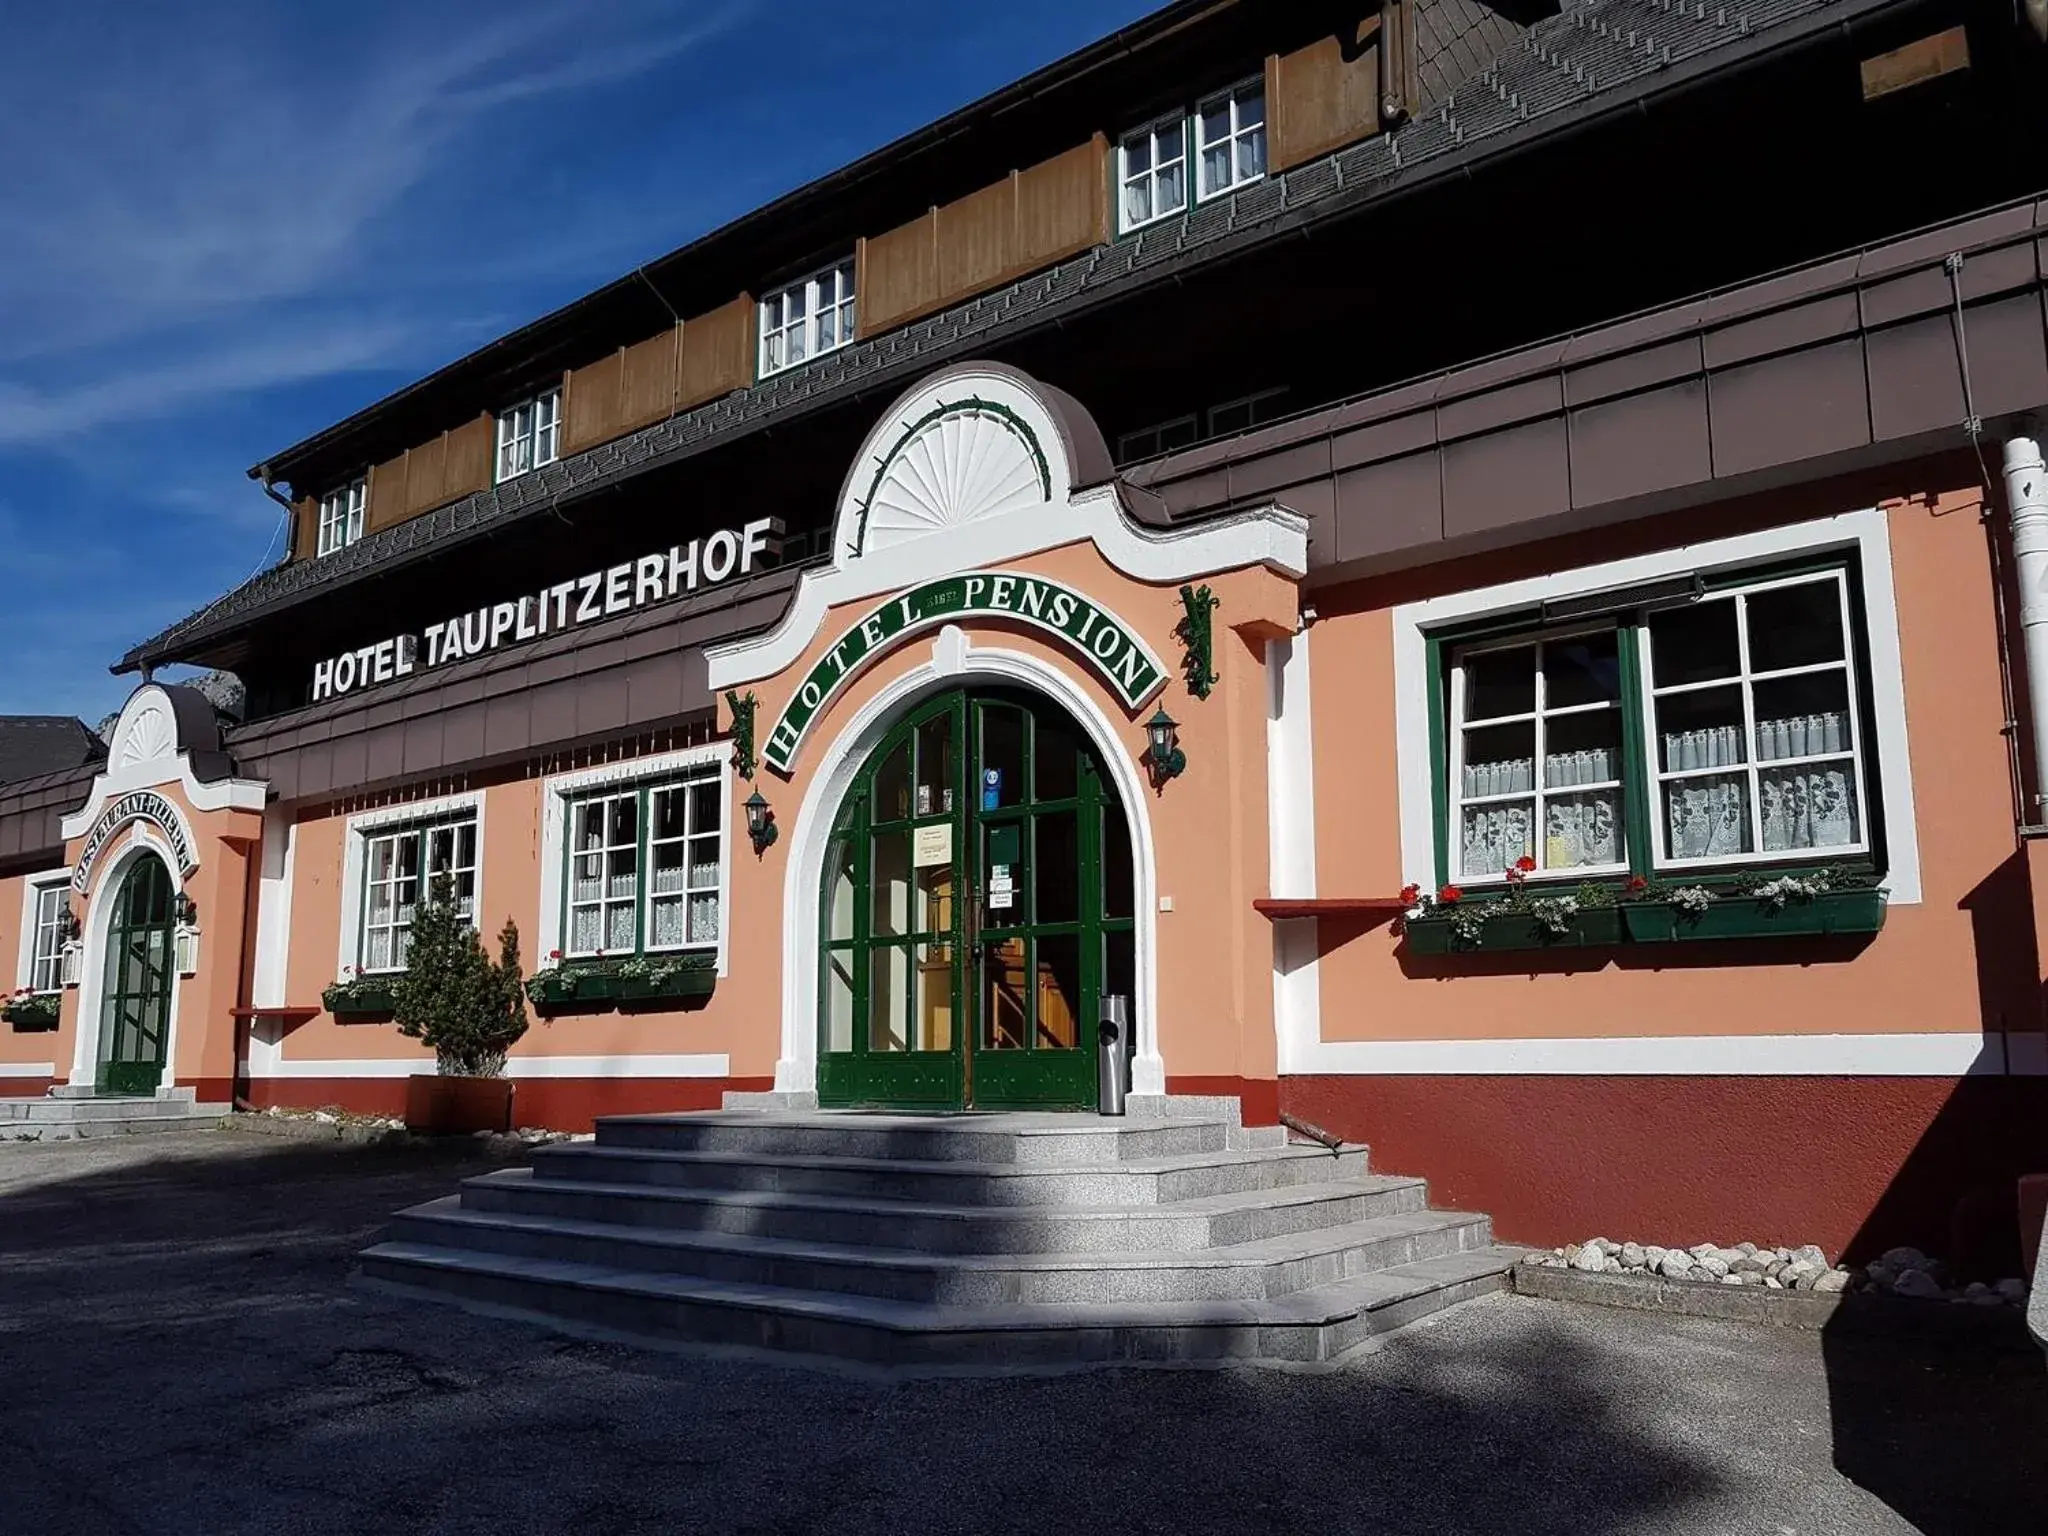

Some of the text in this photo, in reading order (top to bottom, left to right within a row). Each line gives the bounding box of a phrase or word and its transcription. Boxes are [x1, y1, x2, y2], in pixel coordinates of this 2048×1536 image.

[312, 517, 773, 701] HOTEL TAUPLITZERHOF
[770, 576, 1150, 756] HOTEL PENSION
